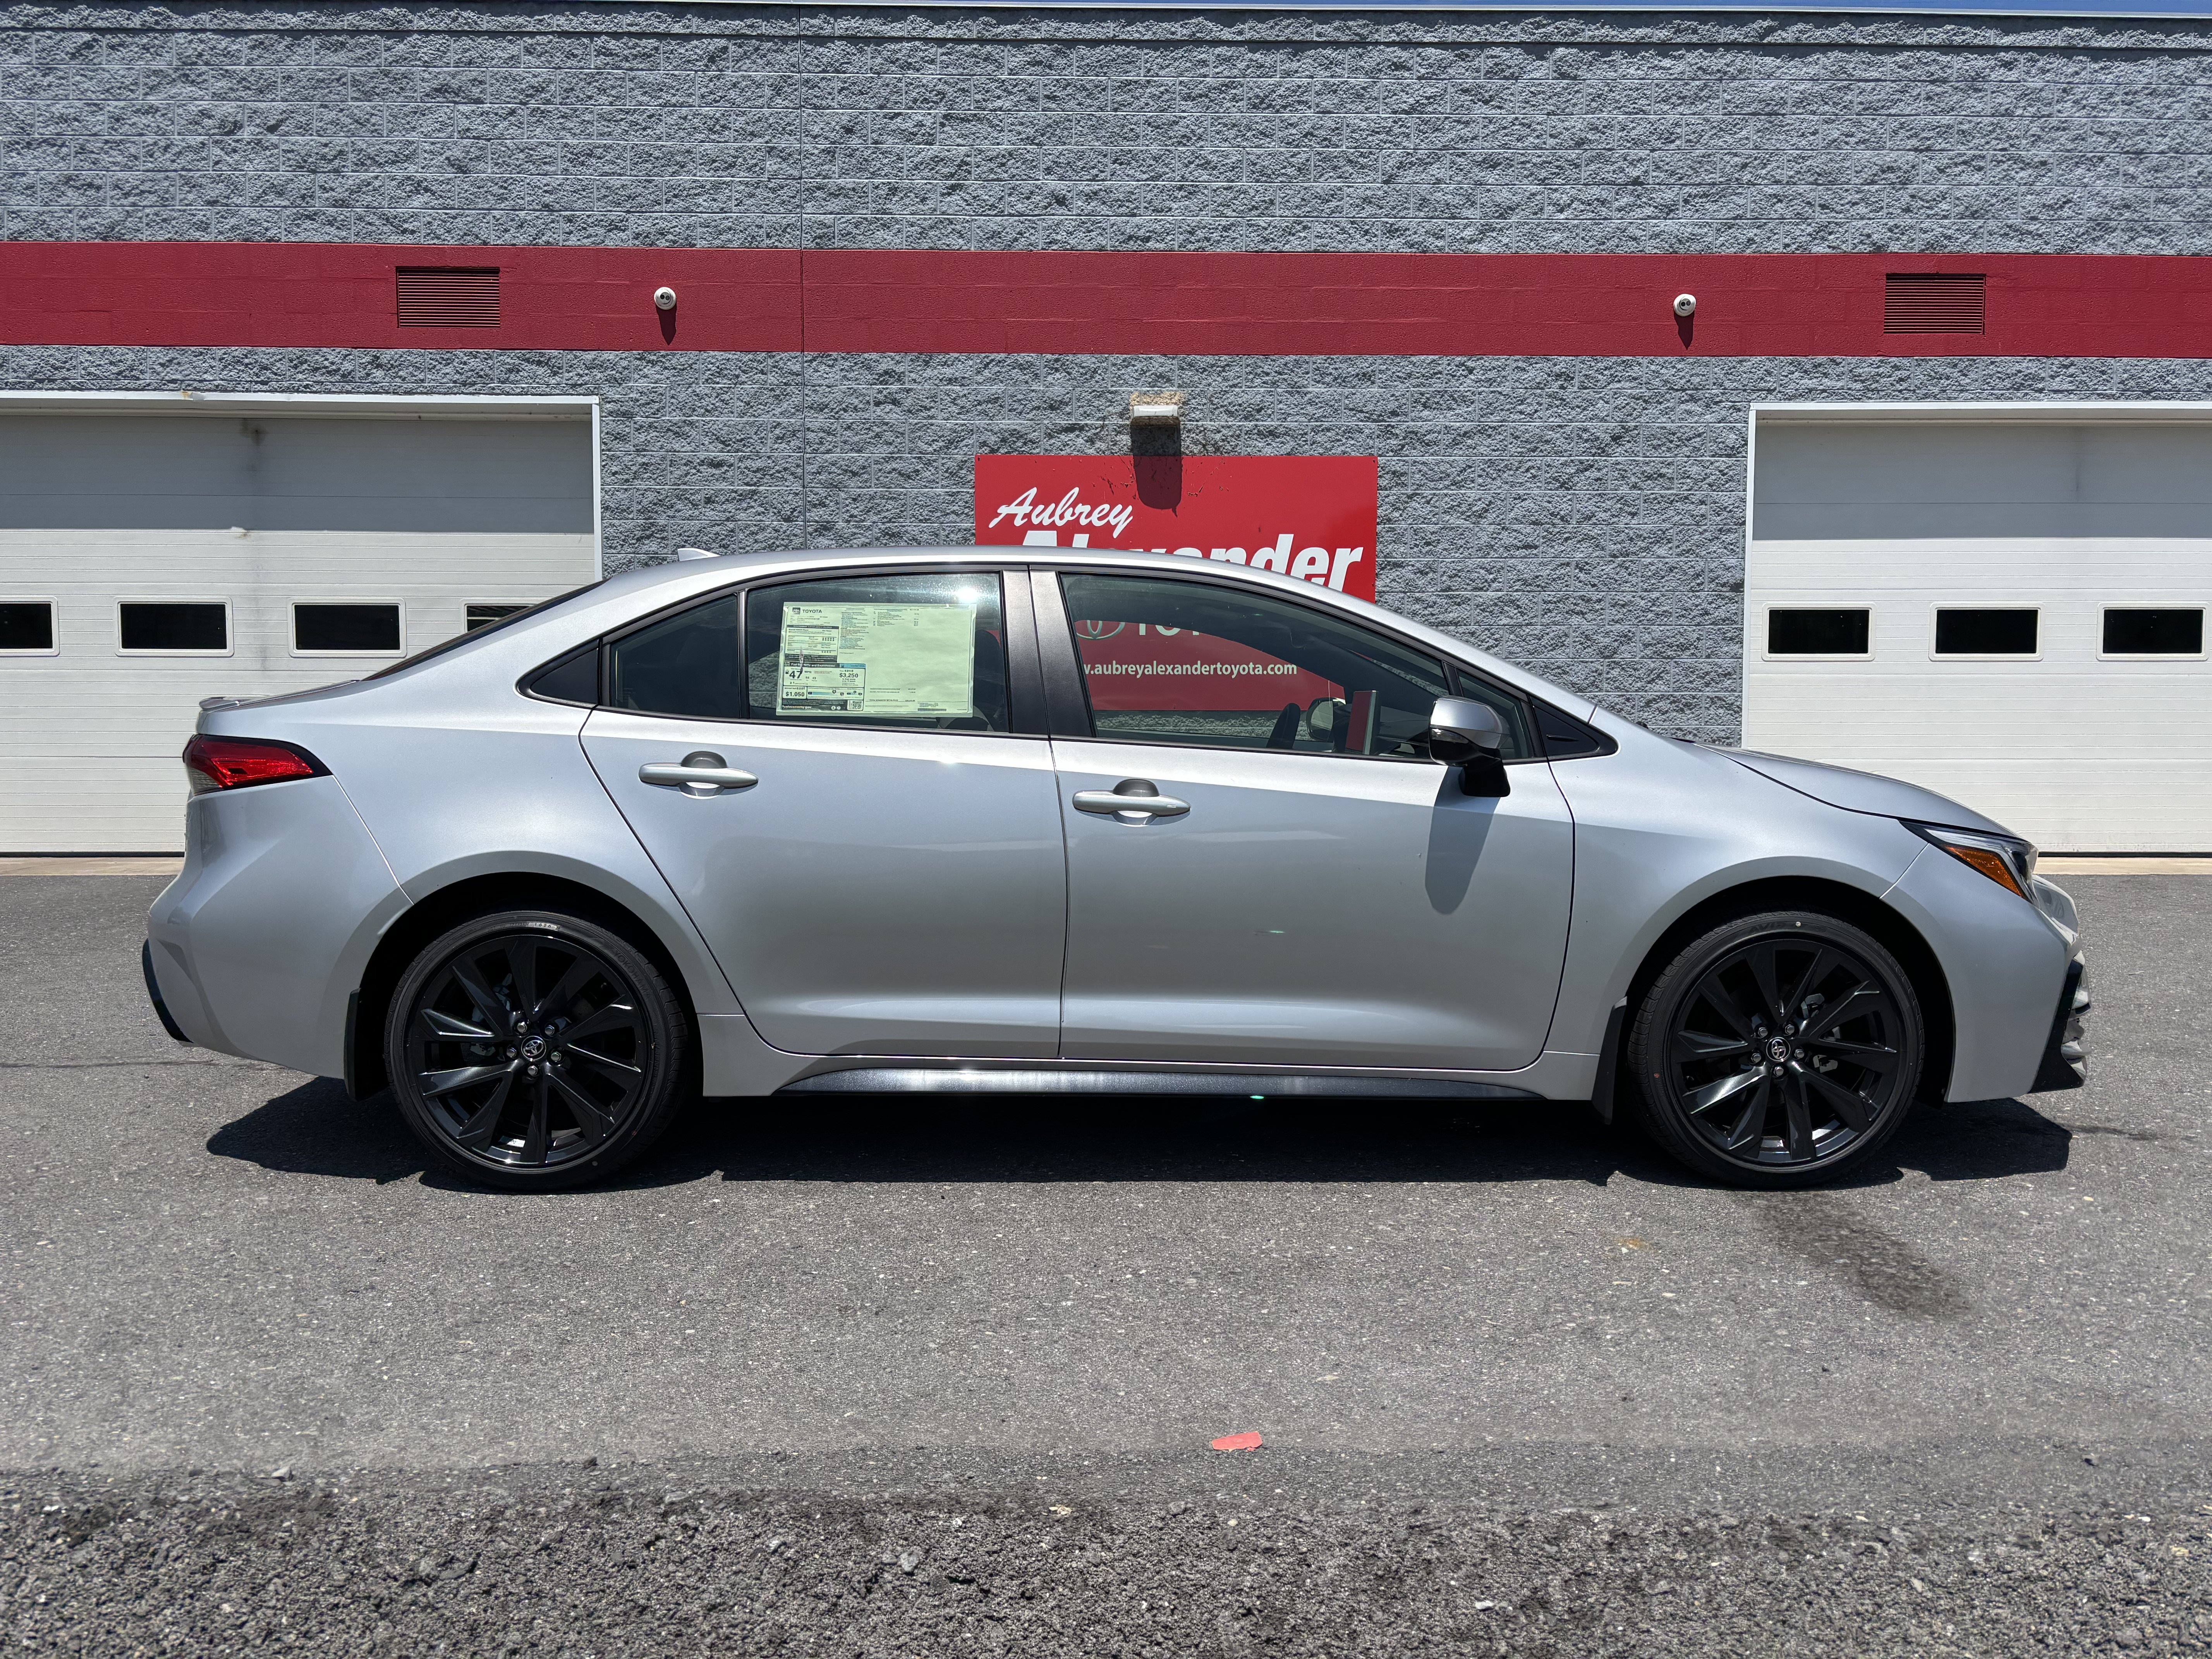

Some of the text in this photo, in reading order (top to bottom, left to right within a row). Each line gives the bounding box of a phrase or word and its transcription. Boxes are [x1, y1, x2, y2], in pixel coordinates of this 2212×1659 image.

[988, 486, 1133, 539] Aubrey
[789, 670, 803, 679] 47
[614, 950, 651, 999] YOKOHAMA
